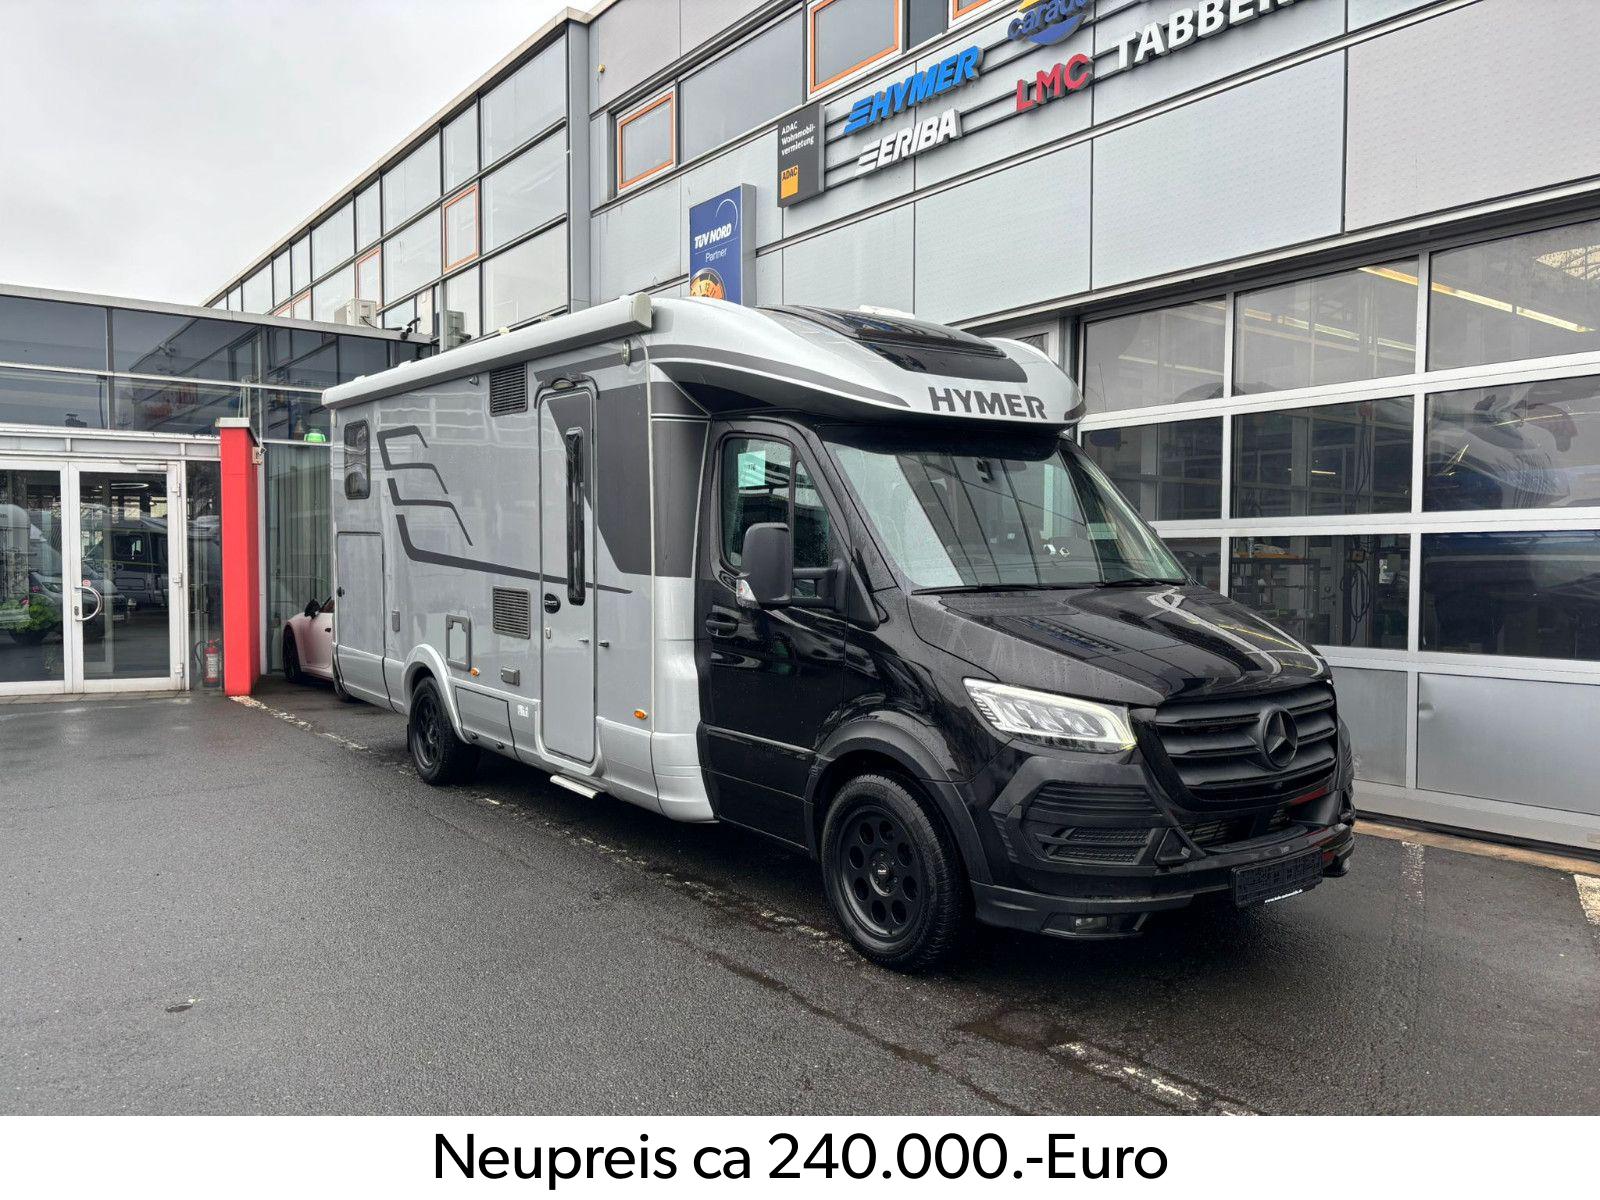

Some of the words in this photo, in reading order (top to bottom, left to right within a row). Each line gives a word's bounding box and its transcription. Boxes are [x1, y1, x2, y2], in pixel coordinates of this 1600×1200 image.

[869, 46, 980, 123] HYMER
[1016, 53, 1092, 112] LMC
[781, 121, 798, 136] ADAC
[781, 123, 816, 146] Wohnmobil-
[876, 108, 959, 169] ERIBA
[781, 135, 815, 156] vermietung
[782, 166, 798, 181] ADAC
[709, 223, 732, 242] NORD
[705, 248, 727, 262] Partner
[928, 386, 1048, 420] HYMER
